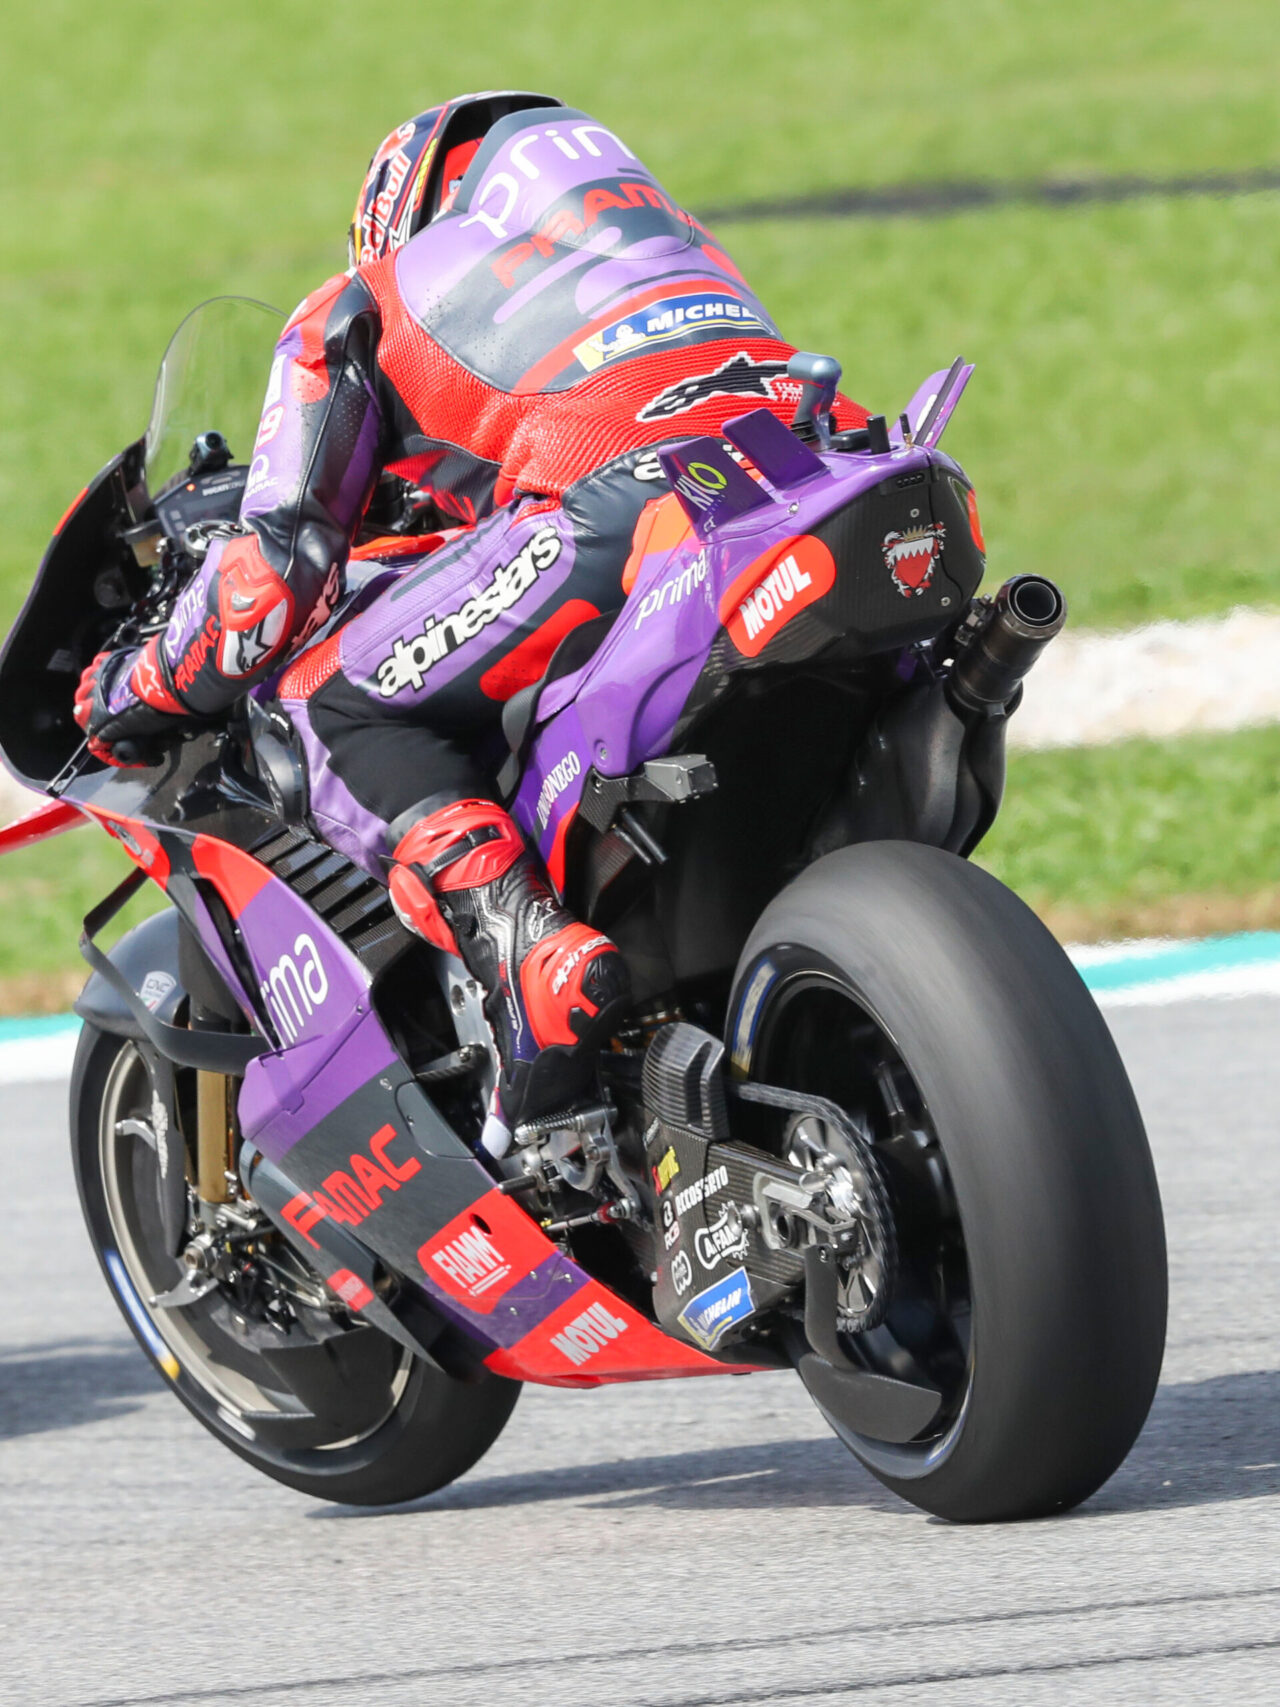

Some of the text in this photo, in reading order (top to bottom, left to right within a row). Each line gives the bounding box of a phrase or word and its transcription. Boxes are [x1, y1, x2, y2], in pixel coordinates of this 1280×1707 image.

[374, 148, 412, 228] Bull
[646, 303, 756, 333] MICHEL
[377, 526, 564, 697] alpinestars
[634, 548, 708, 630] prima
[737, 554, 813, 641] MOTUL
[431, 1225, 506, 1289] FIAMM
[549, 1301, 629, 1367] MOTUL
